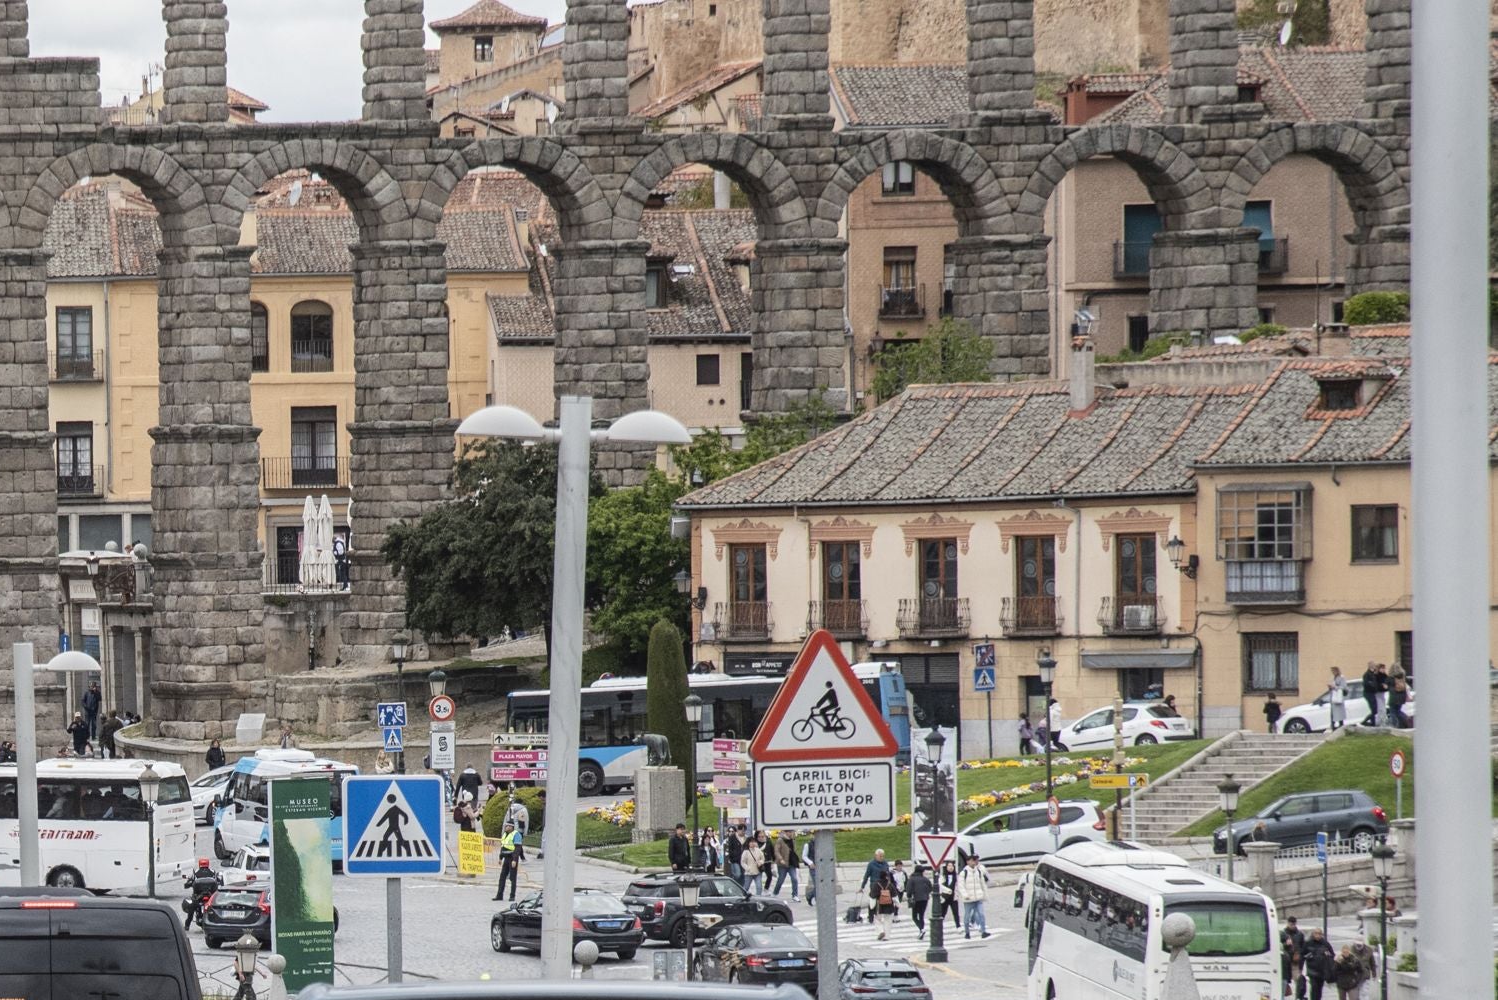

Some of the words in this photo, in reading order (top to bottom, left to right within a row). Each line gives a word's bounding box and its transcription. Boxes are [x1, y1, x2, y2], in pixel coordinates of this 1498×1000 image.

[782, 771, 832, 782] CARRIL
[839, 769, 870, 780] BICI:
[799, 783, 855, 794] PEATON
[780, 796, 839, 807] CIRCULE
[845, 795, 873, 805] POR
[792, 809, 809, 820] LA
[817, 808, 862, 819] ACERA
